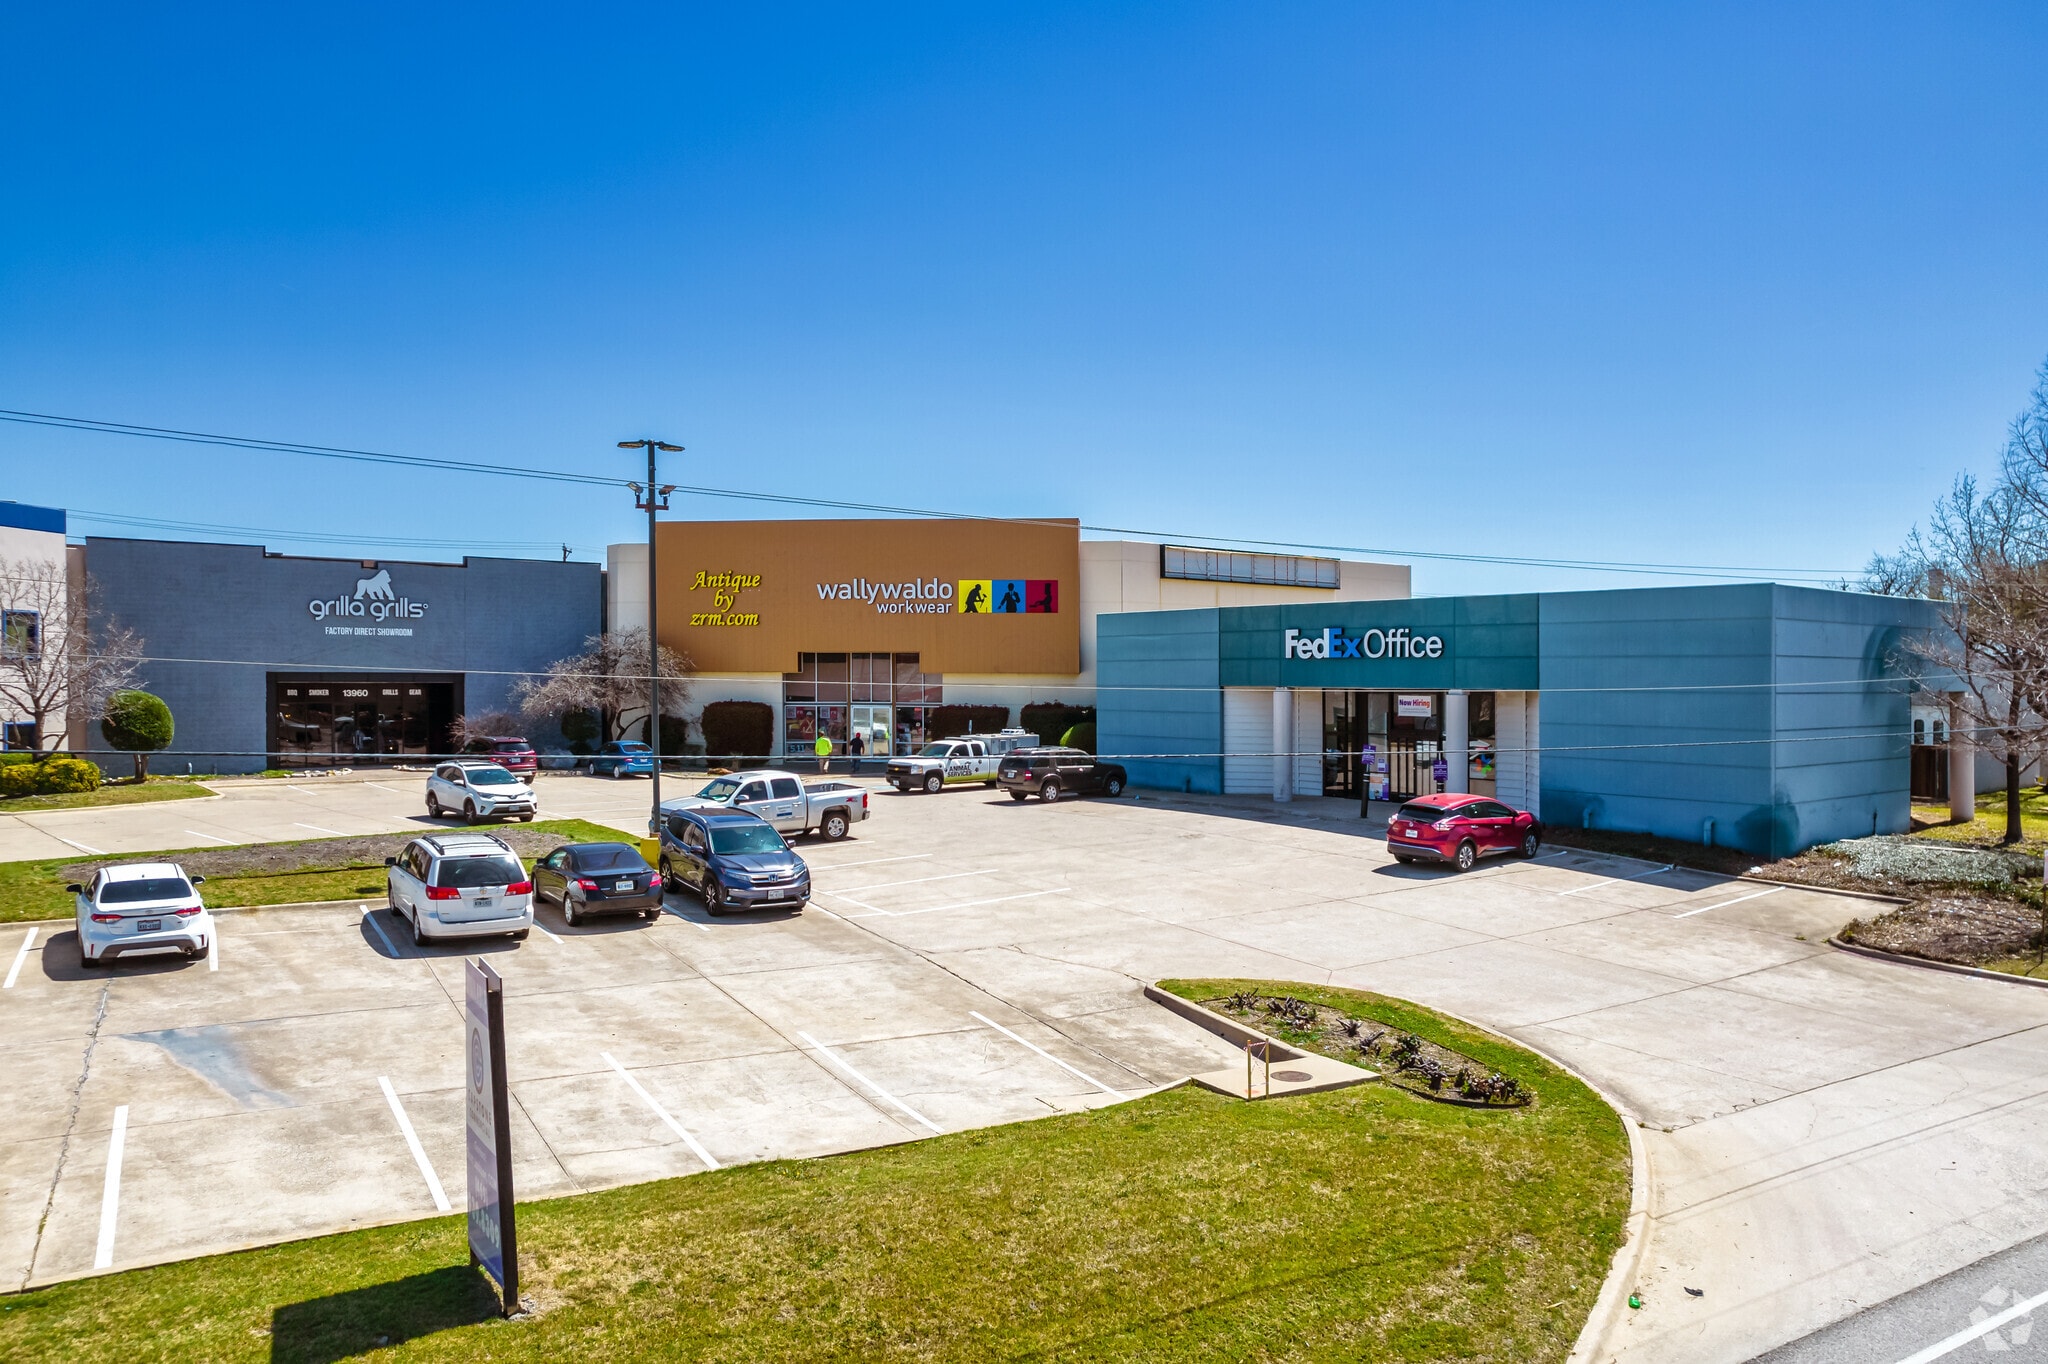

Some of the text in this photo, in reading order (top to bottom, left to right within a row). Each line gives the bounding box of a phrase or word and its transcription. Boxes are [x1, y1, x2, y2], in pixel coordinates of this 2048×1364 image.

[690, 570, 761, 593] Antique
[714, 588, 734, 613] by
[816, 578, 953, 605] wallywaldo
[309, 595, 365, 621] grilla
[876, 600, 952, 614] workwear
[689, 613, 759, 626] zrm.com
[325, 626, 413, 637] FACTORY DIRECT SHOWROOM
[1285, 627, 1443, 660] FedEx Office
[342, 689, 368, 697] 13960
[1399, 698, 1431, 709] Now Hiring
